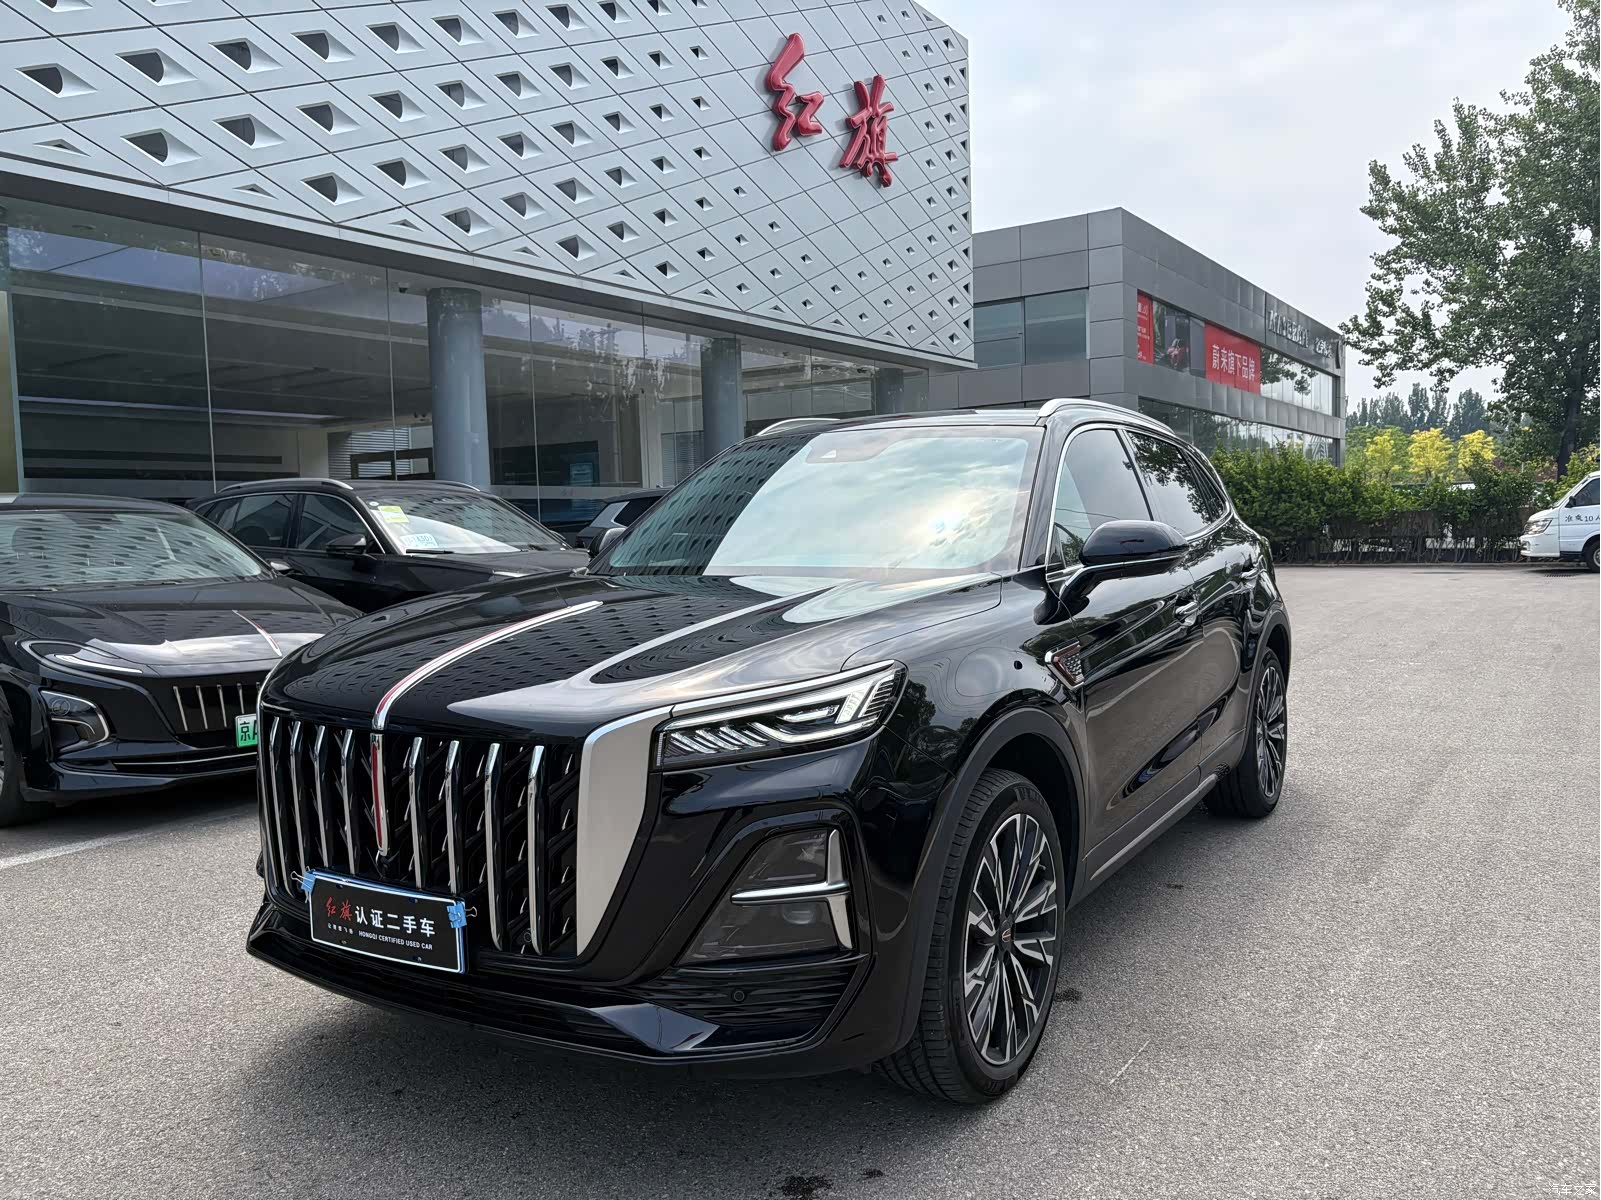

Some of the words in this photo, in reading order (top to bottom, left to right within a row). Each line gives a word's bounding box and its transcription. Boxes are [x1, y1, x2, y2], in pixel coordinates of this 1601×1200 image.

[764, 33, 899, 188] 红旗
[1212, 343, 1255, 382] 蔚来旗下品牌
[358, 930, 378, 940] HONGQI
[378, 934, 405, 945] CERTIFIED
[405, 940, 420, 948] USED
[421, 942, 433, 950] CAR
